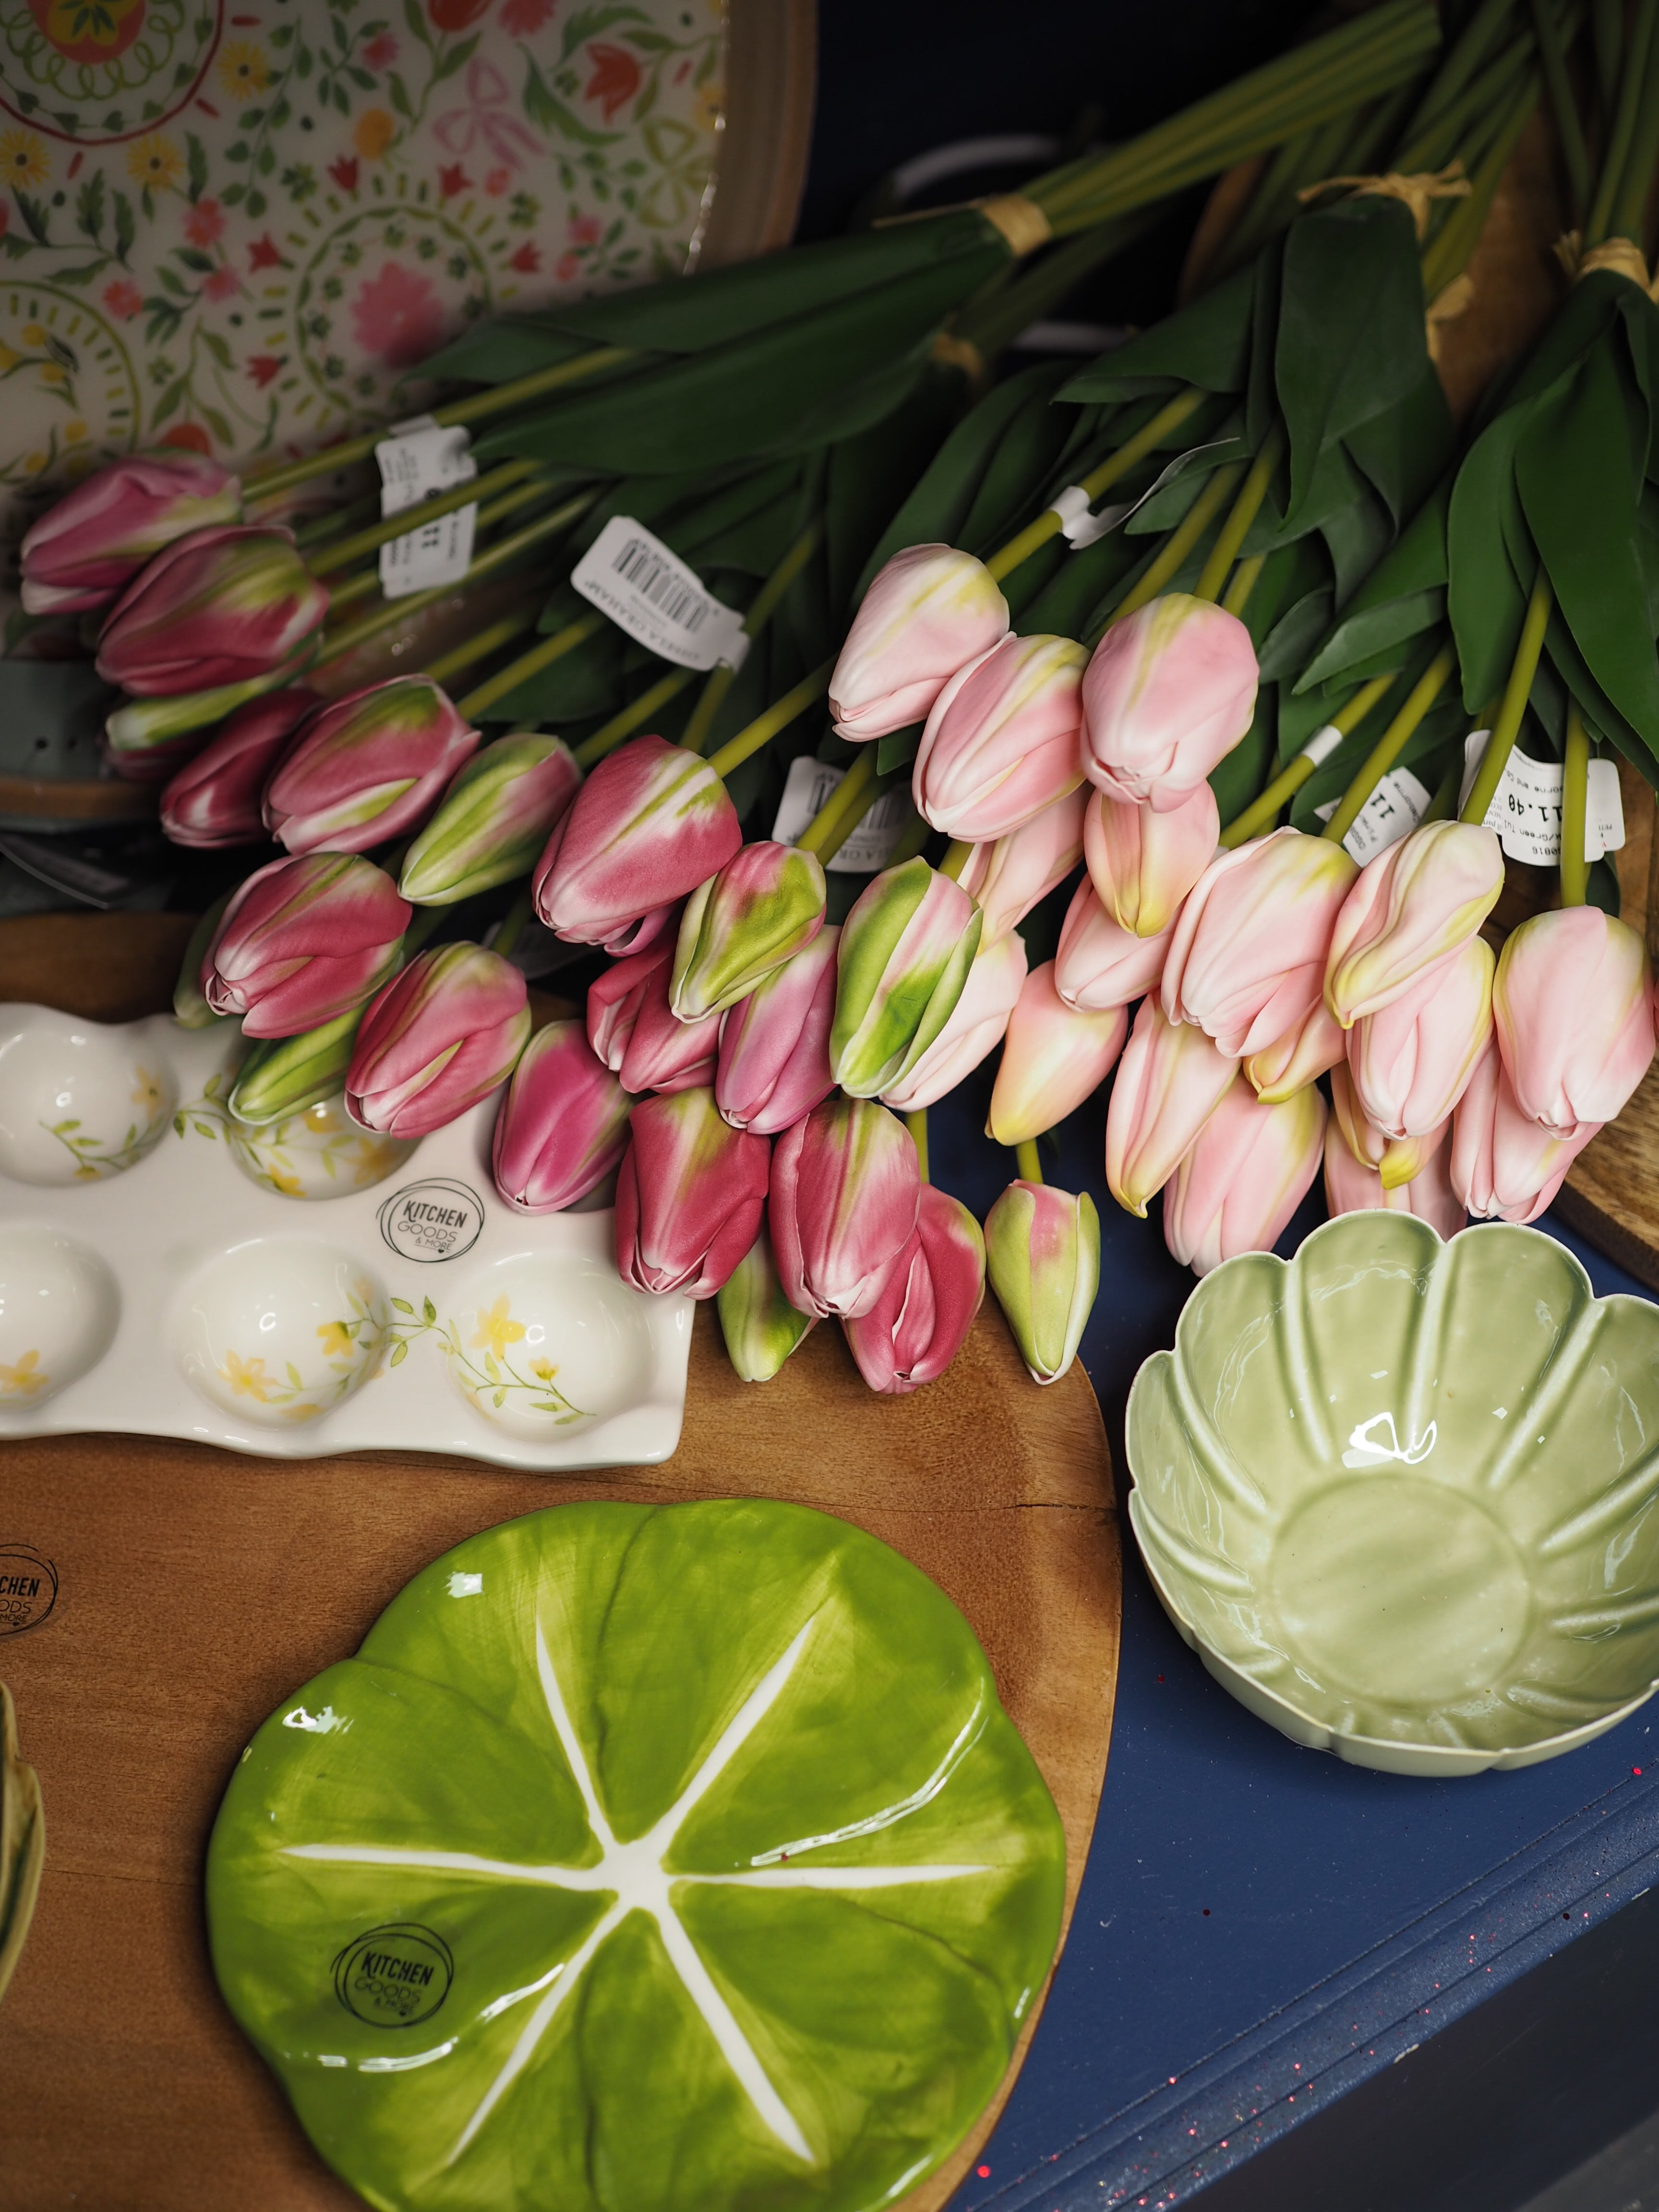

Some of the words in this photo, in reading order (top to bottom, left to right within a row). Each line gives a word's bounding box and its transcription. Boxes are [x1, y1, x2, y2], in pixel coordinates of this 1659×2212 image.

[1508, 793, 1562, 822] 11.40
[1519, 828, 1562, 842] k/Green
[403, 1200, 467, 1228] KITCHEN
[397, 1220, 457, 1242] GOODS
[425, 1238, 453, 1250] MORE
[361, 1951, 434, 1985] KITCHEN
[354, 1977, 423, 2005] GOODS
